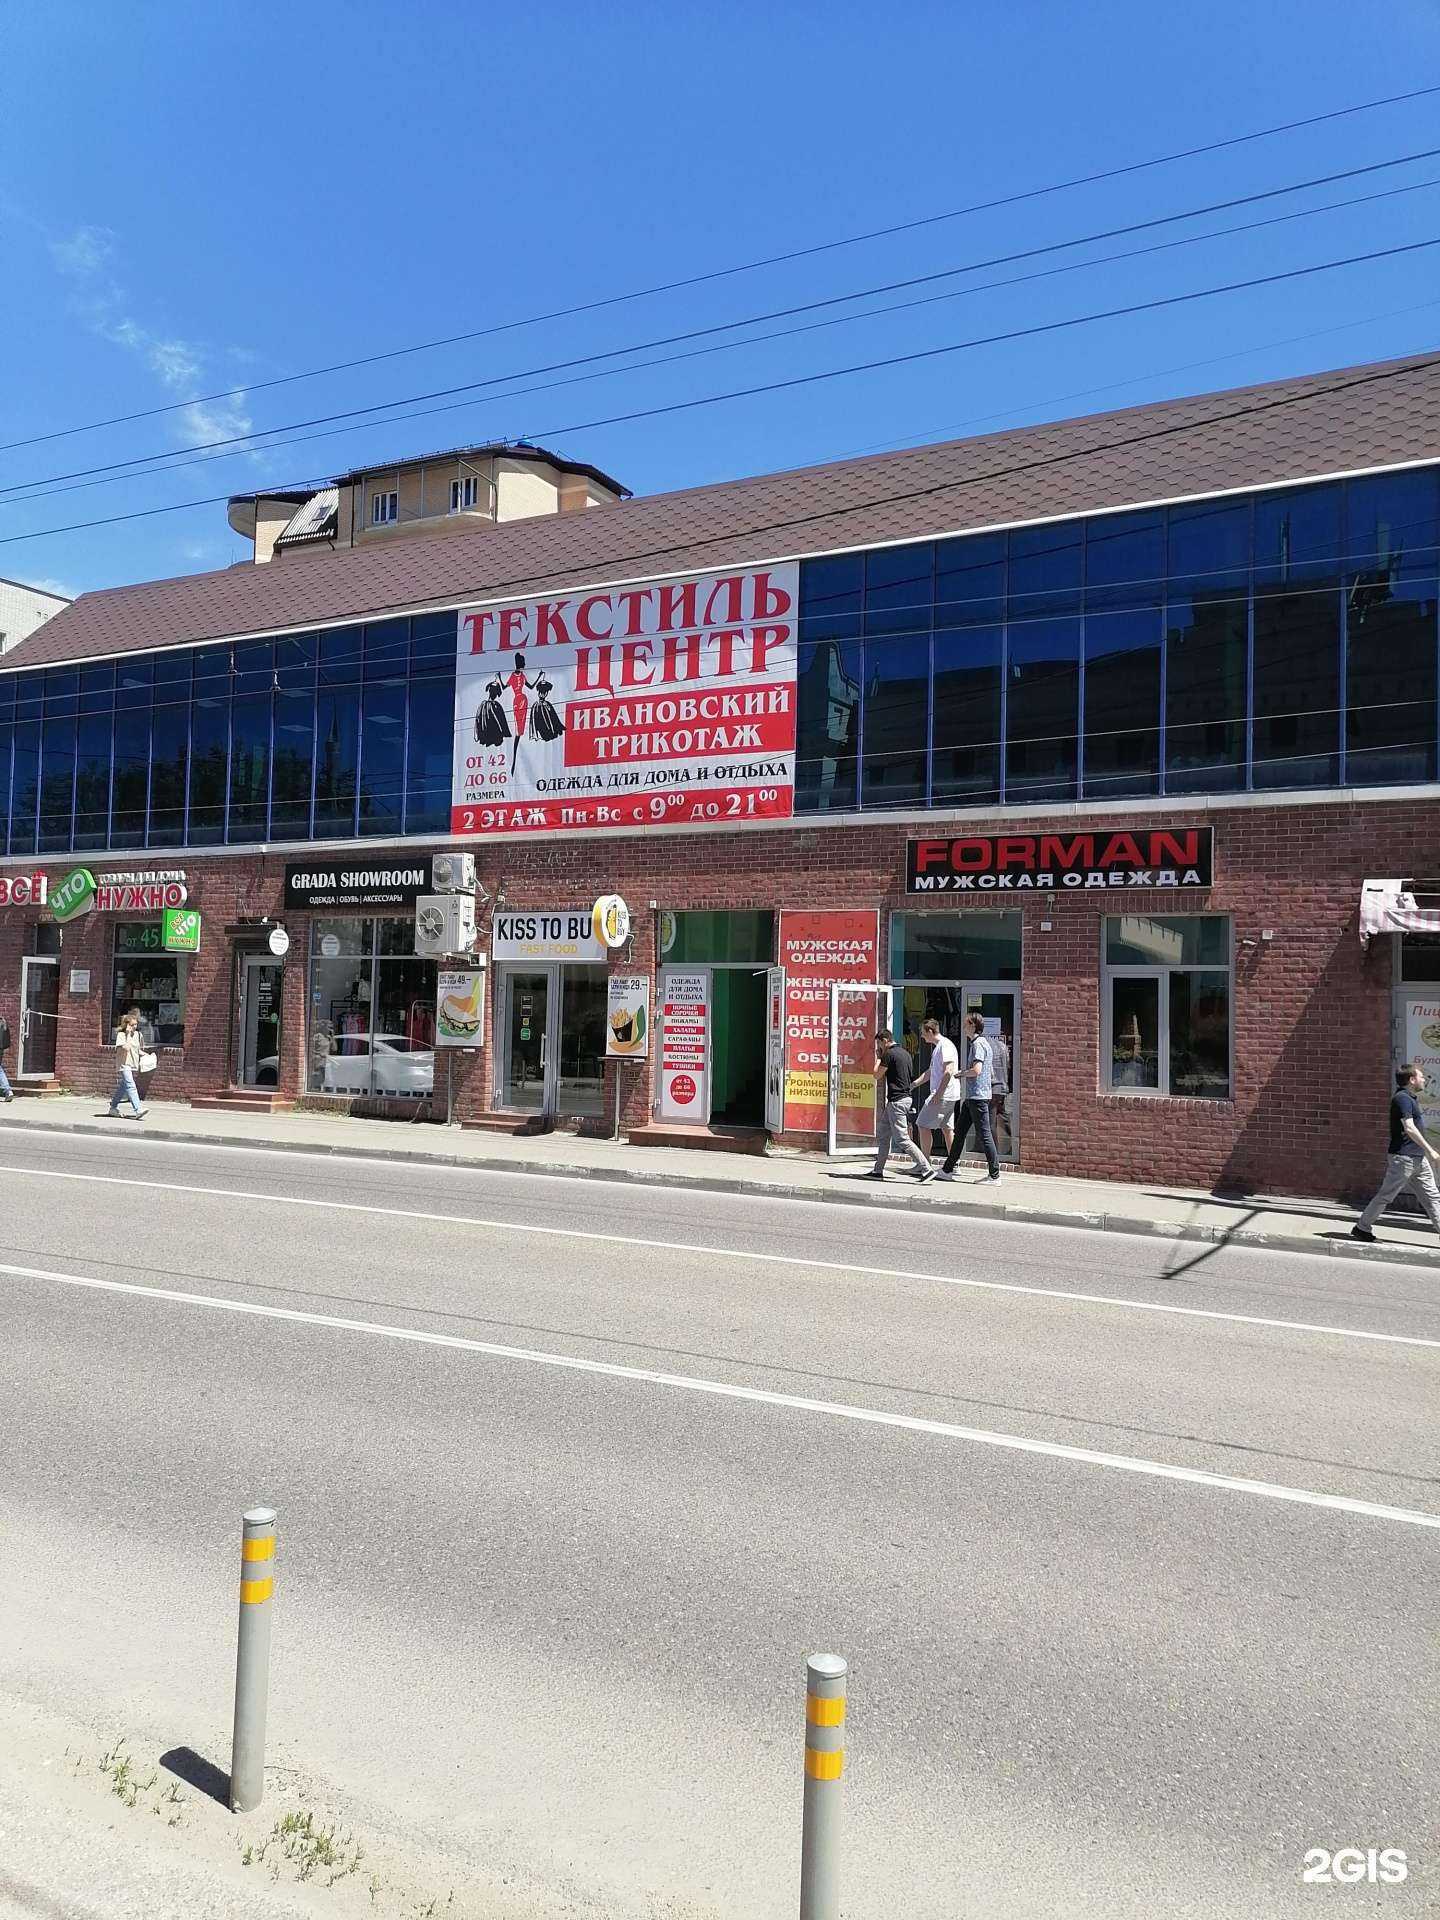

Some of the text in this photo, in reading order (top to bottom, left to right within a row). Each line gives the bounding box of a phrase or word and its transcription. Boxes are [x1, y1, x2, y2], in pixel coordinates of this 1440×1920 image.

[464, 572, 791, 656] ТЕКСТИЛЬ
[573, 624, 791, 698] ЦЕНТР
[572, 686, 790, 731] ИВАНОВСКИЙ
[594, 723, 763, 759] ТРИКОТАЖ
[466, 754, 506, 769] ОТ 42
[464, 771, 507, 788] ДО 66
[536, 762, 788, 792] ОДЕЖДА ДЛЯ ДОМА И ОТДЫХА
[466, 790, 505, 801] РАЗМЕРА
[463, 812, 474, 829] 2
[482, 807, 548, 828] ЭТАЖ
[561, 807, 621, 824] Пн-Вс
[690, 801, 719, 818] до
[916, 831, 1198, 872] FORMAN
[291, 870, 425, 889] GRADA SHOWROOM
[915, 869, 1201, 890] МУЖСКАЯ ОДЕЖДА
[51, 873, 86, 910] ЧТО
[97, 883, 187, 911] НУЖНО
[309, 894, 403, 904] ОДЕЖДА ОБУВЬ АКСЕССУАРЫ
[140, 928, 159, 949] 45
[498, 917, 592, 940] KISS TO BU
[786, 940, 873, 951] МУЖСКАЯ
[790, 953, 868, 964] ОДЕЖДА
[785, 1079, 828, 1088] ГРОМНЫ
[839, 1092, 862, 1100] ЕНЫ
